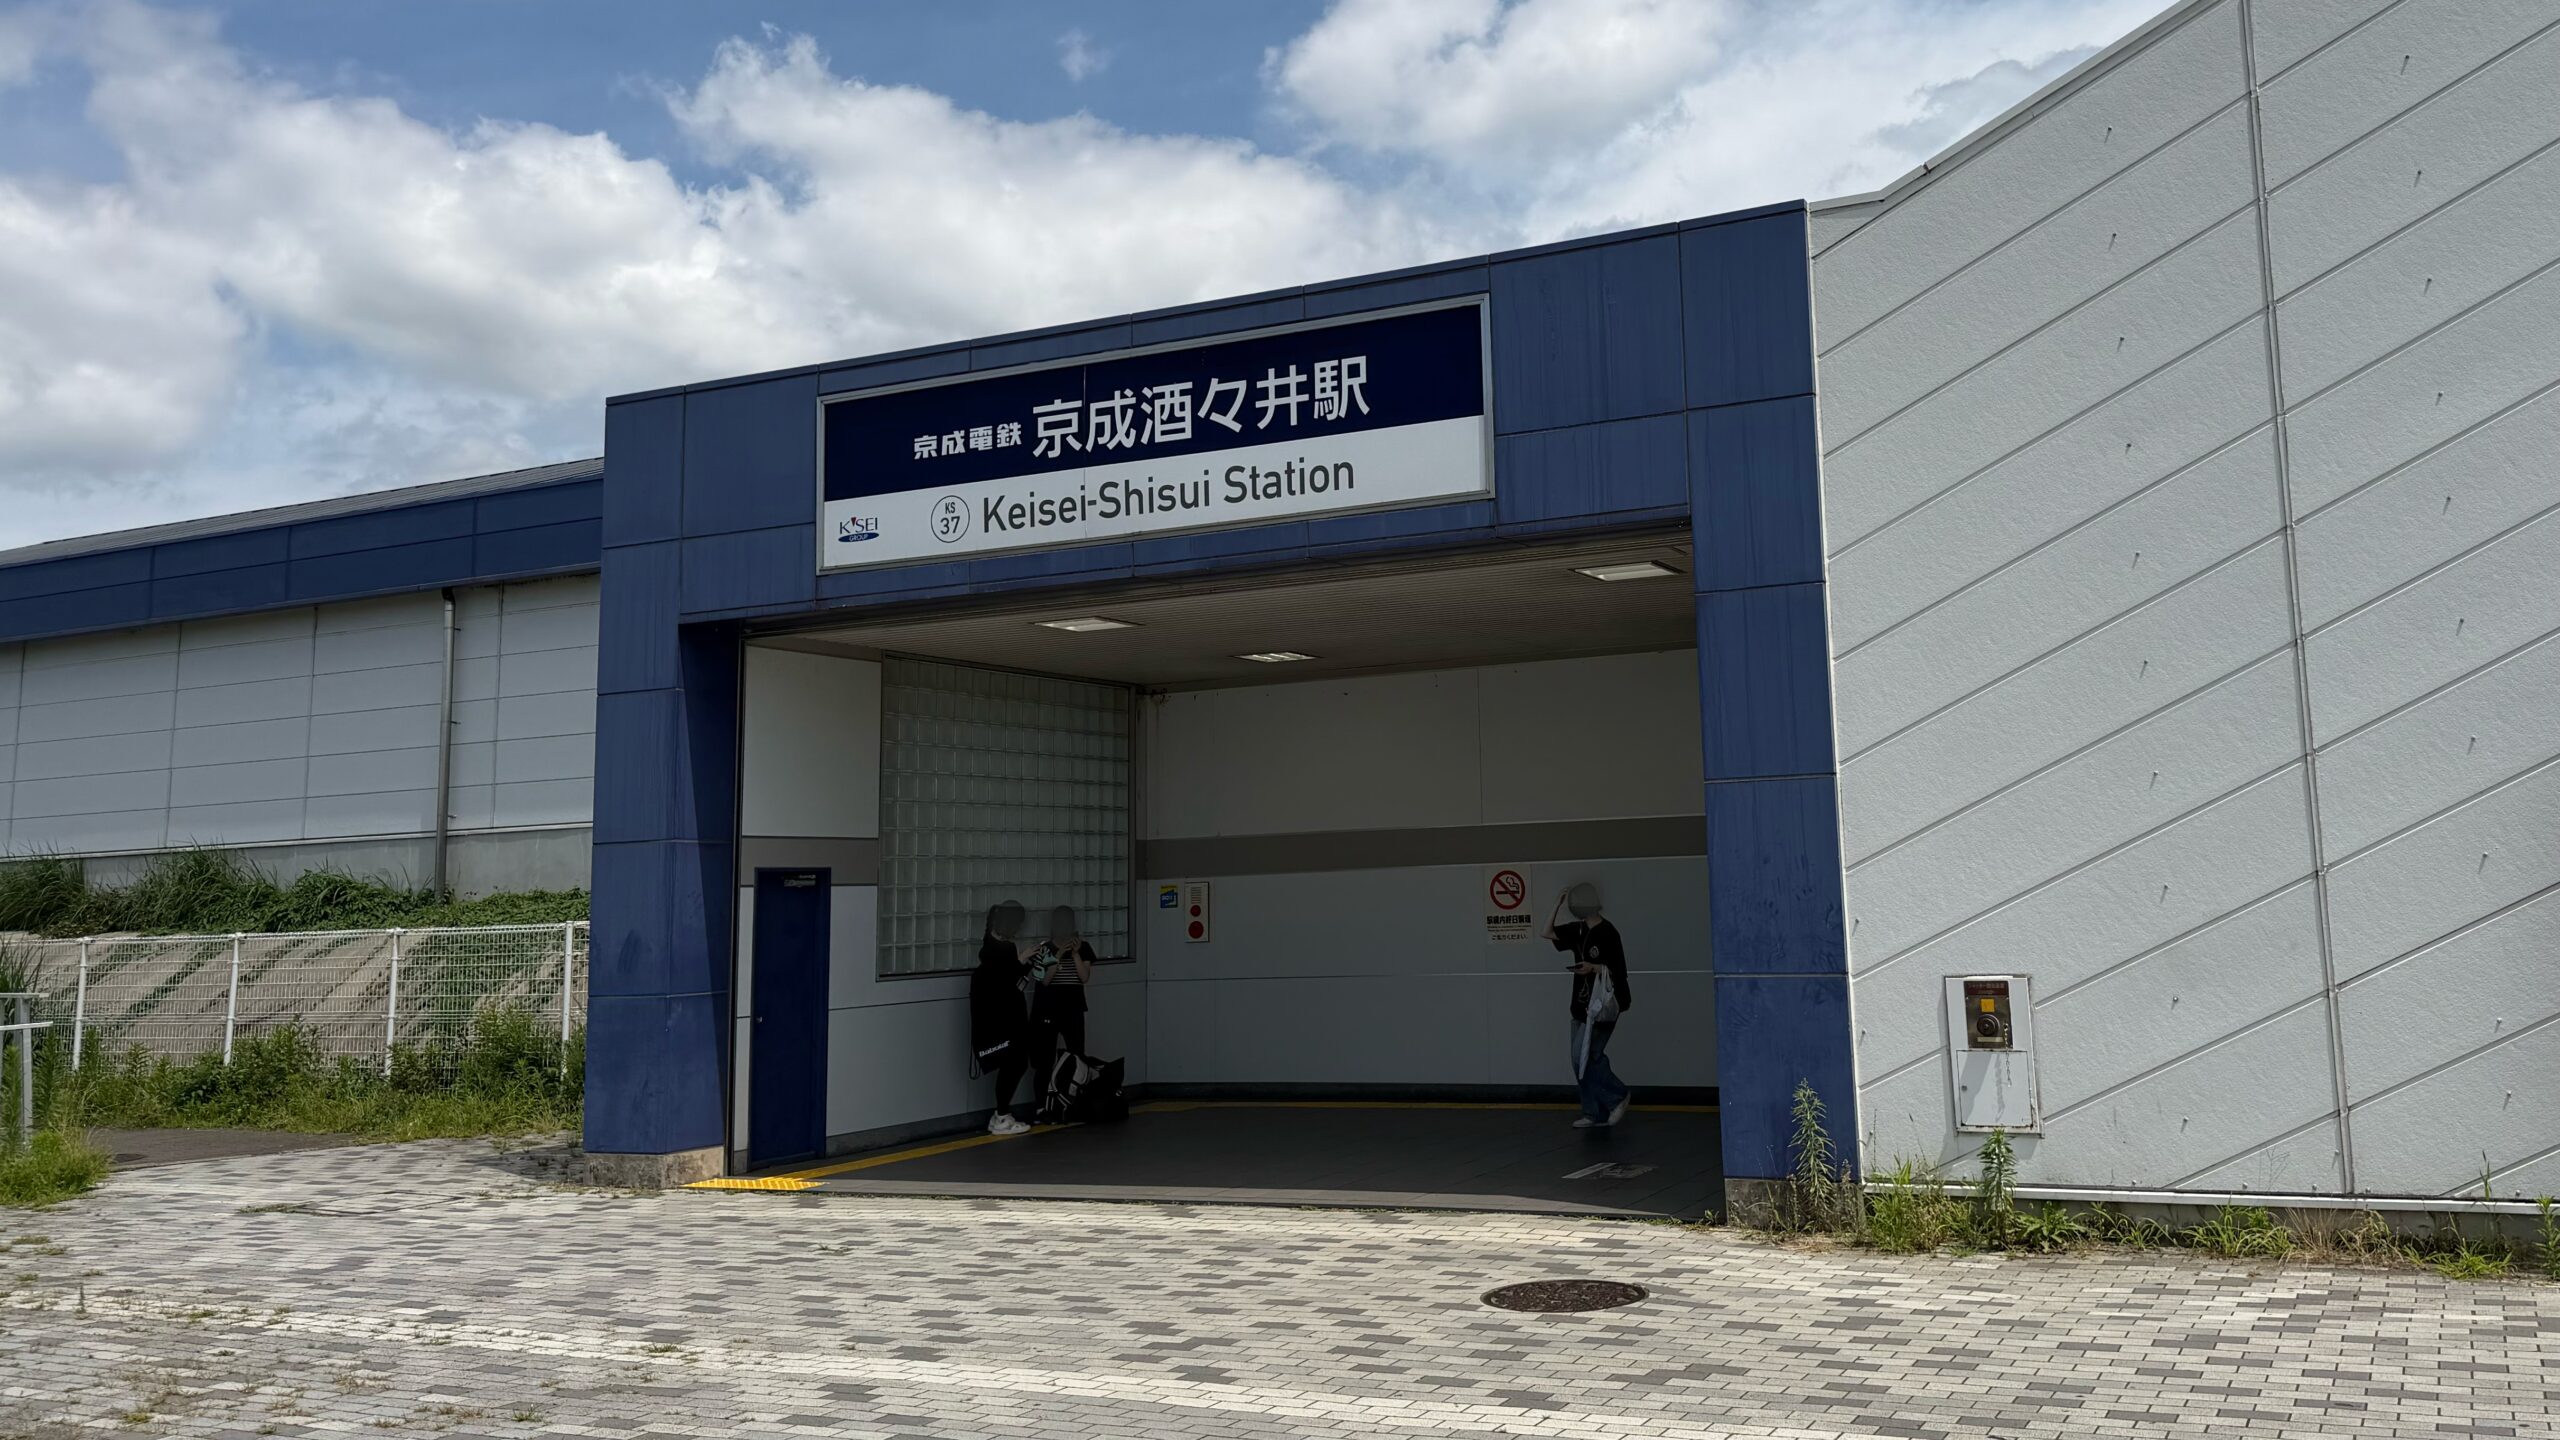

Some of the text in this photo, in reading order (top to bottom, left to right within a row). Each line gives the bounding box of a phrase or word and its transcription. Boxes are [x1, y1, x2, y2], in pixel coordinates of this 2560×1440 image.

[914, 355, 1370, 460] 京成電鉄 京成酒々井駅
[983, 456, 1355, 534] Keisei-Shisui Station
[946, 502, 956, 514] KS
[941, 516, 960, 535] 37
[849, 533, 869, 542] GROUP
